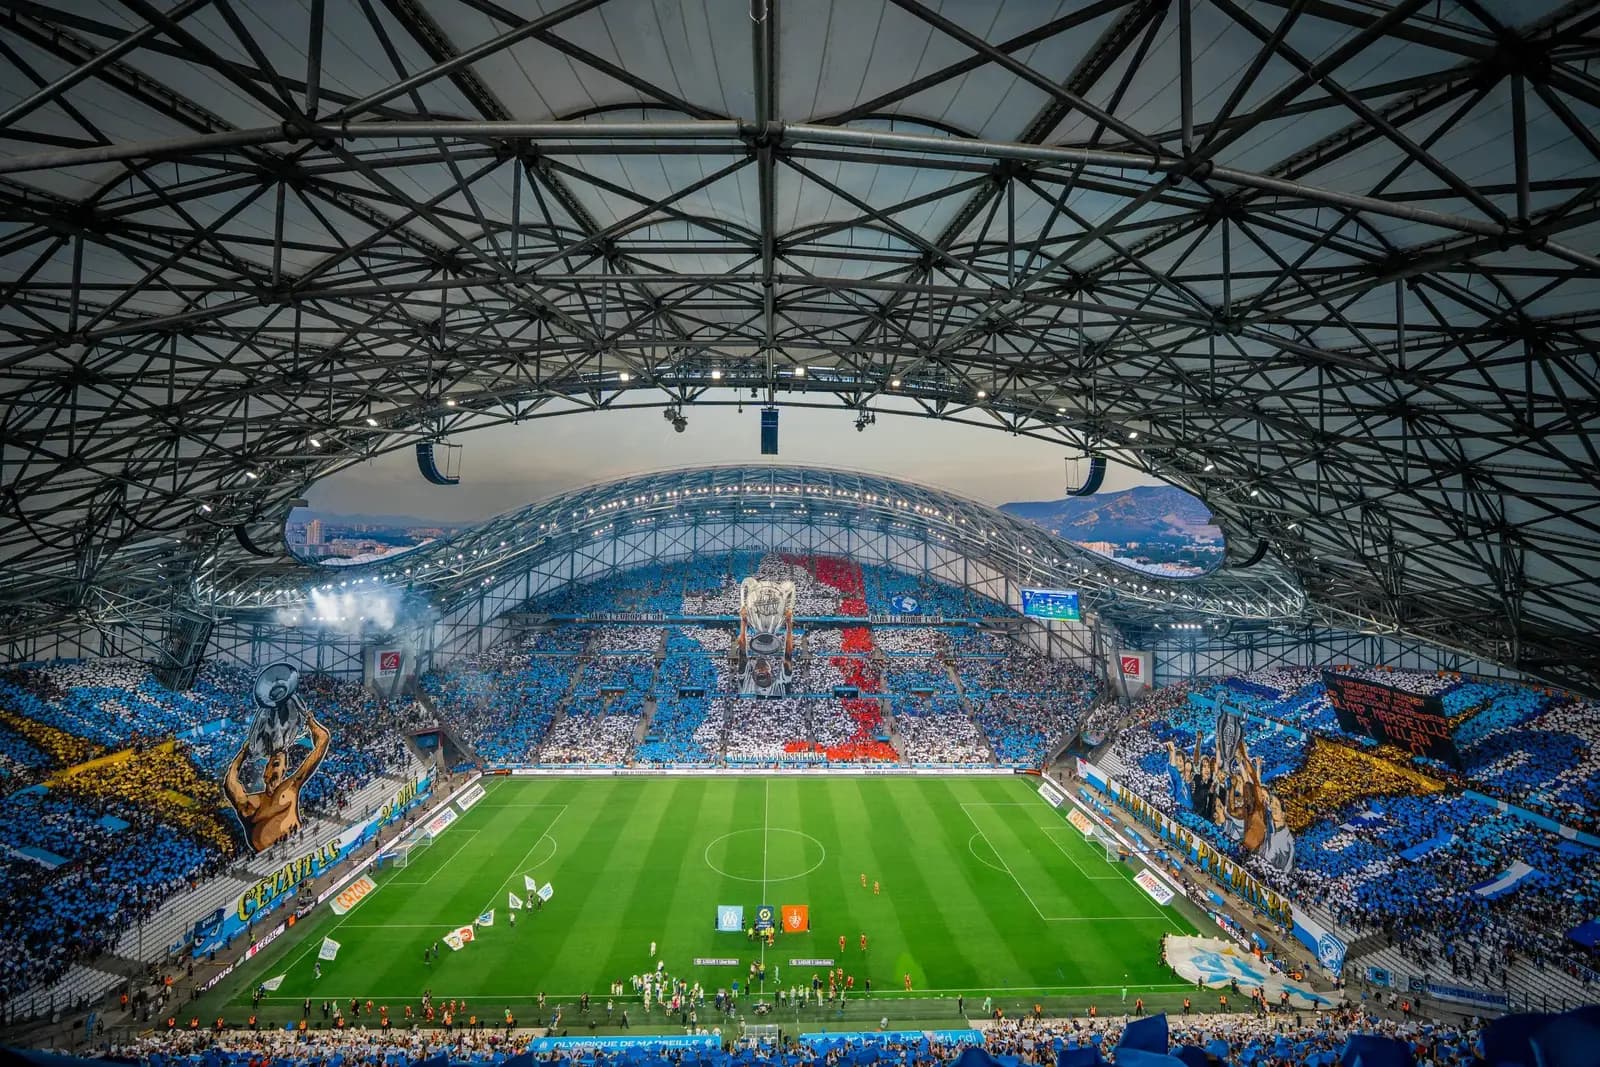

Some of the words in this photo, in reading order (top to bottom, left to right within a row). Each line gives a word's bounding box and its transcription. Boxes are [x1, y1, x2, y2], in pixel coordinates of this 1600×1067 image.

[1197, 840, 1294, 931] PREMIERS
[553, 1040, 617, 1049] OLYMPIQUE
[619, 1040, 634, 1048] DE
